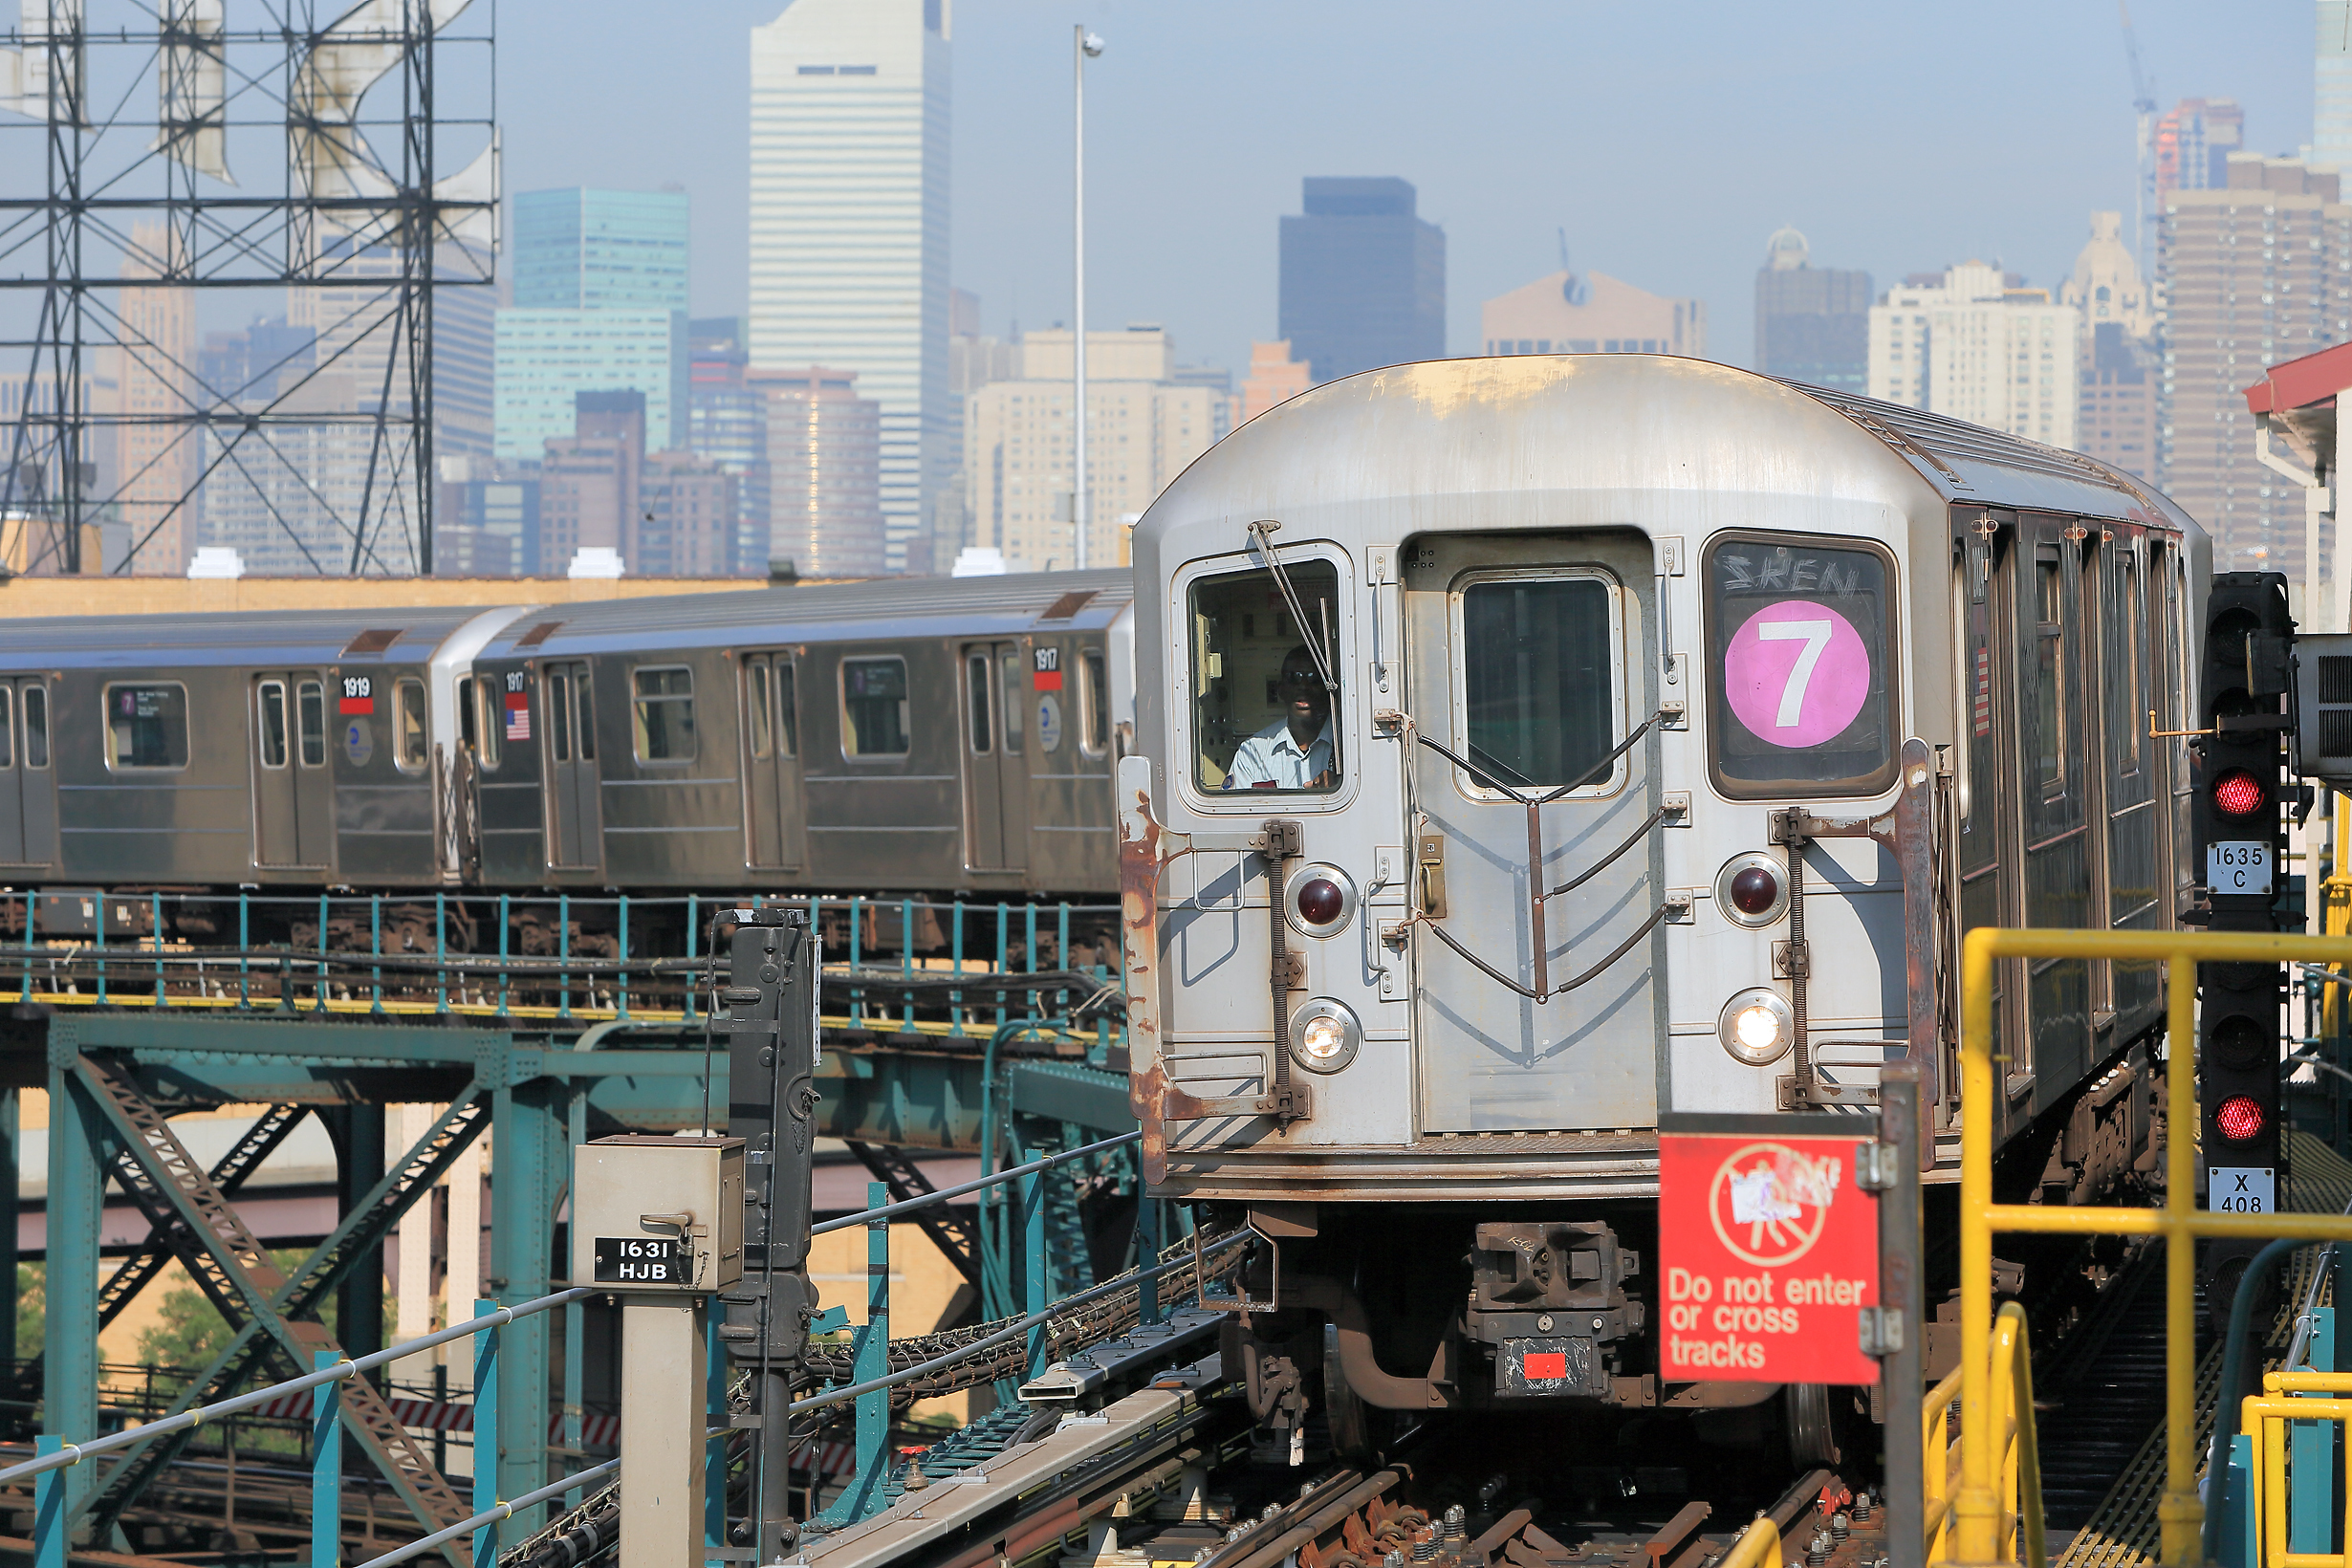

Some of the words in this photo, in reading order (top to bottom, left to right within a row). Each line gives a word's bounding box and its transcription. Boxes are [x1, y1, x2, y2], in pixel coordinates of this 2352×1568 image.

[1035, 647, 1057, 671] 1917
[506, 671, 524, 693] 1917
[1758, 620, 1833, 728] 7
[343, 677, 371, 698] 1919
[2216, 847, 2263, 866] 1635
[2233, 869, 2246, 888] C
[2233, 1174, 2250, 1192] X
[2221, 1196, 2262, 1213] 408
[620, 1241, 668, 1258] 1631
[619, 1262, 667, 1280] HJB
[1668, 1267, 1712, 1302] Do
[1724, 1271, 1774, 1304] not
[1785, 1273, 1866, 1306] enter
[1668, 1303, 1702, 1331] or
[1712, 1304, 1799, 1334] cross
[1669, 1334, 1766, 1368] tracks
